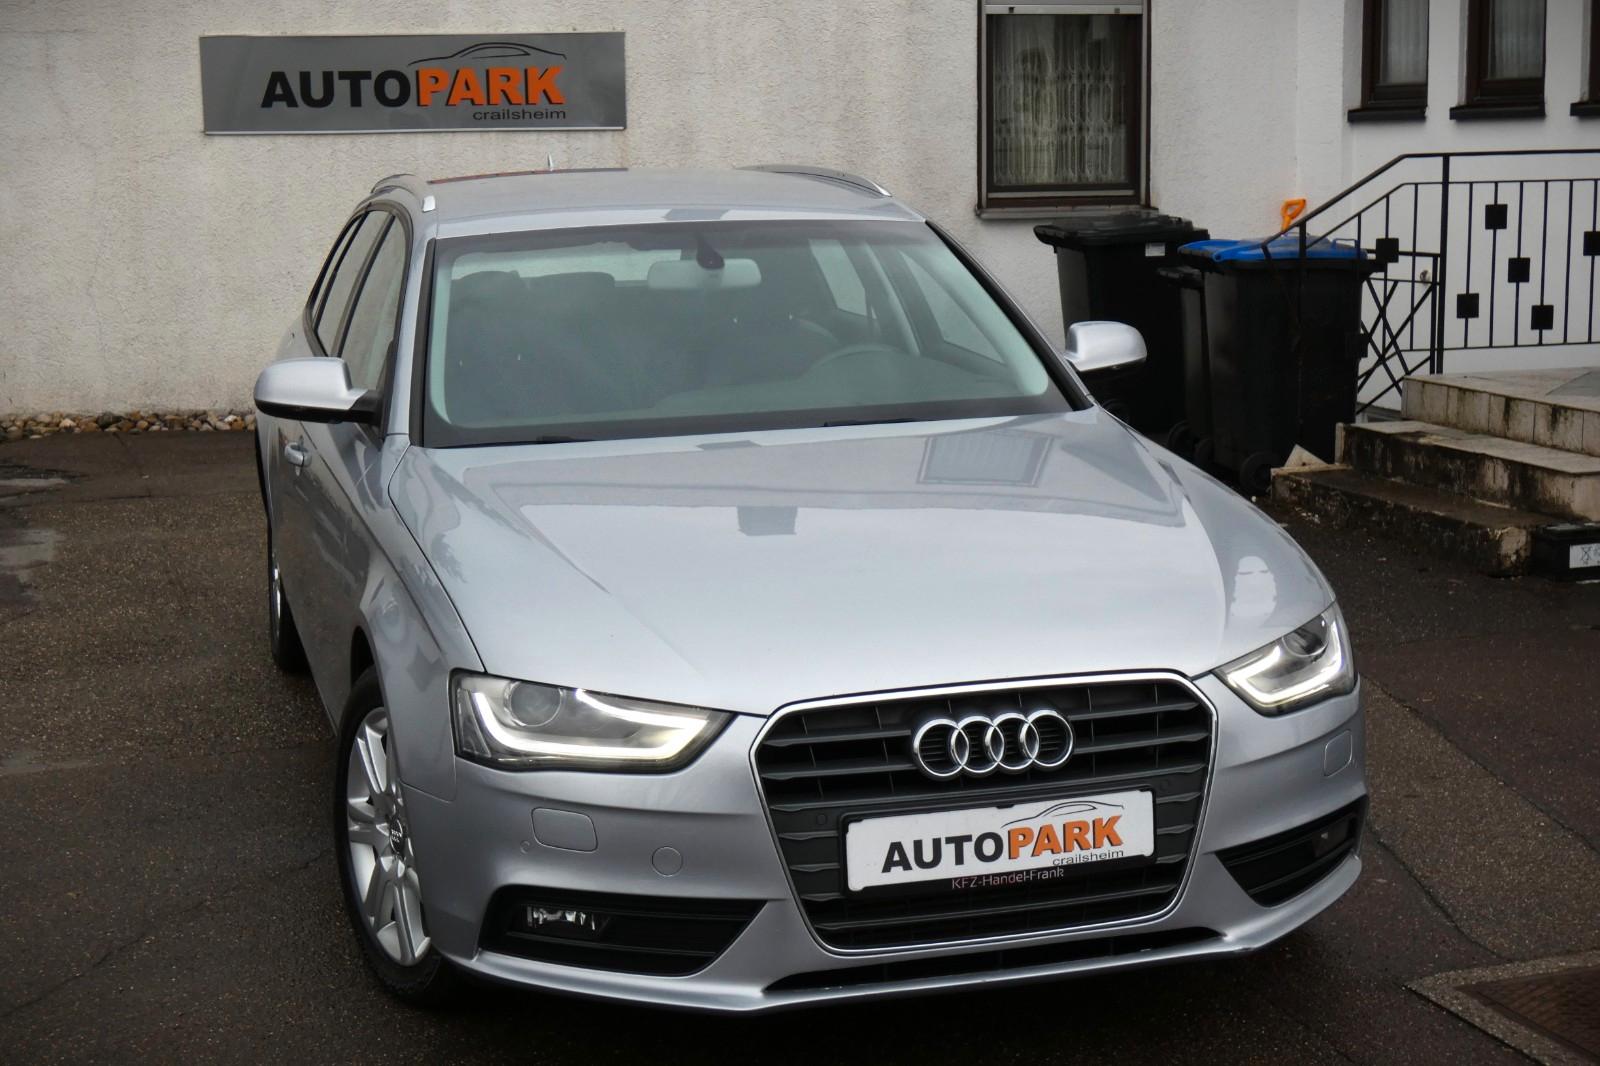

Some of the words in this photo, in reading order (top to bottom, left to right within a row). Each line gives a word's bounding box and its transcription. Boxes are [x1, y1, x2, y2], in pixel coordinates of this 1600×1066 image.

[261, 66, 565, 108] AUTOPARK
[473, 108, 566, 121] crailsheim
[881, 815, 1123, 873] AUTOPARK
[1052, 849, 1124, 866] crailsheim
[952, 867, 1064, 889] KFZ-Handel-Frank
